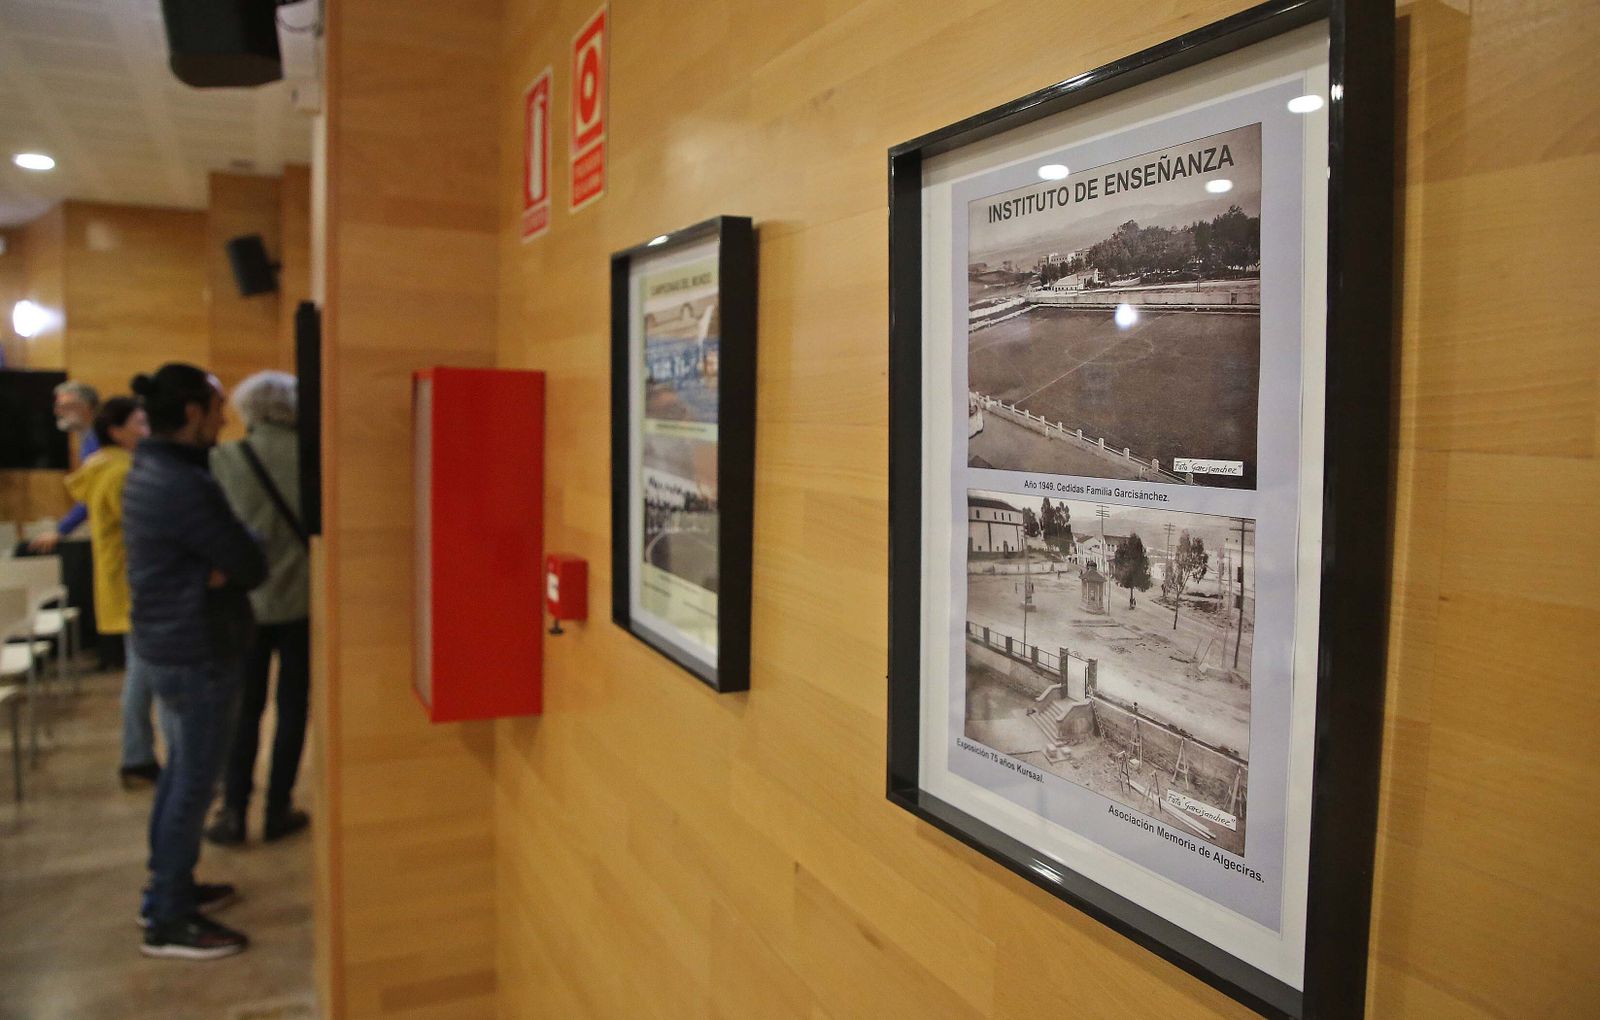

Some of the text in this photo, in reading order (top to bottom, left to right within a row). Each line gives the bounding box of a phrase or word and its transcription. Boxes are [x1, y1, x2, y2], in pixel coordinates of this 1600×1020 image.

[988, 144, 1234, 223] INSTITUTO DE ENSEÑANZA
[1024, 480, 1170, 502] Año 1949. Cedidas Familia Garcisánchez.
[956, 737, 1045, 784] Exposición 75 años Kursaal.
[1108, 804, 1265, 884] Asociación Memoria de Algeciras.
